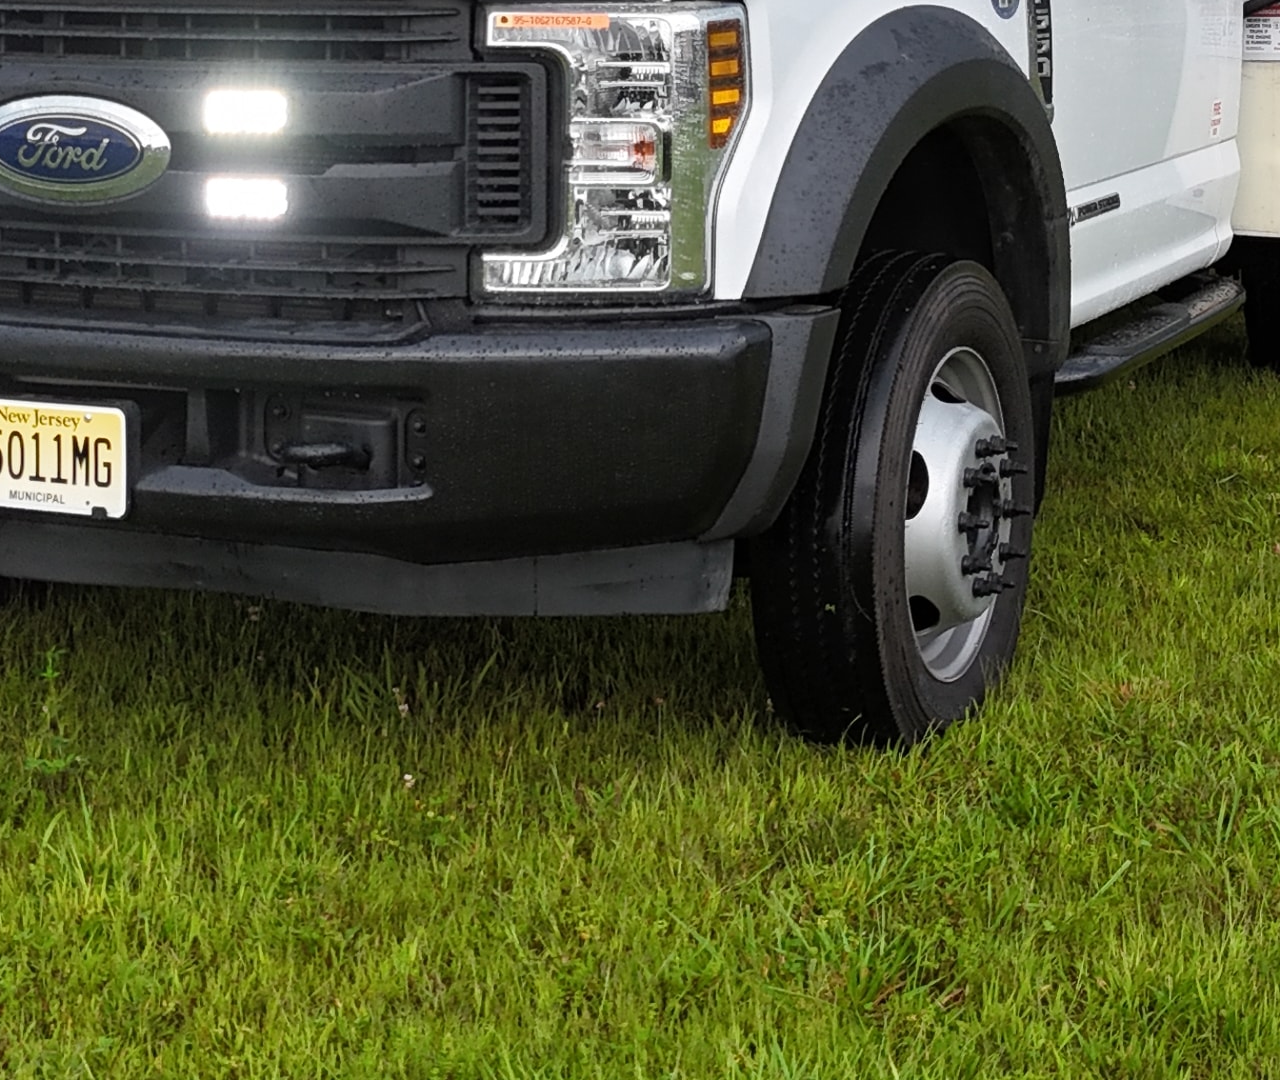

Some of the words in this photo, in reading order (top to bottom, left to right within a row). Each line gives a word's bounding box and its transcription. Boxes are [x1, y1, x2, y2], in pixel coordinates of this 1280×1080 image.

[18, 123, 111, 171] Ford
[32, 409, 81, 432] Jersey
[8, 489, 66, 505] MUNICIPAL
